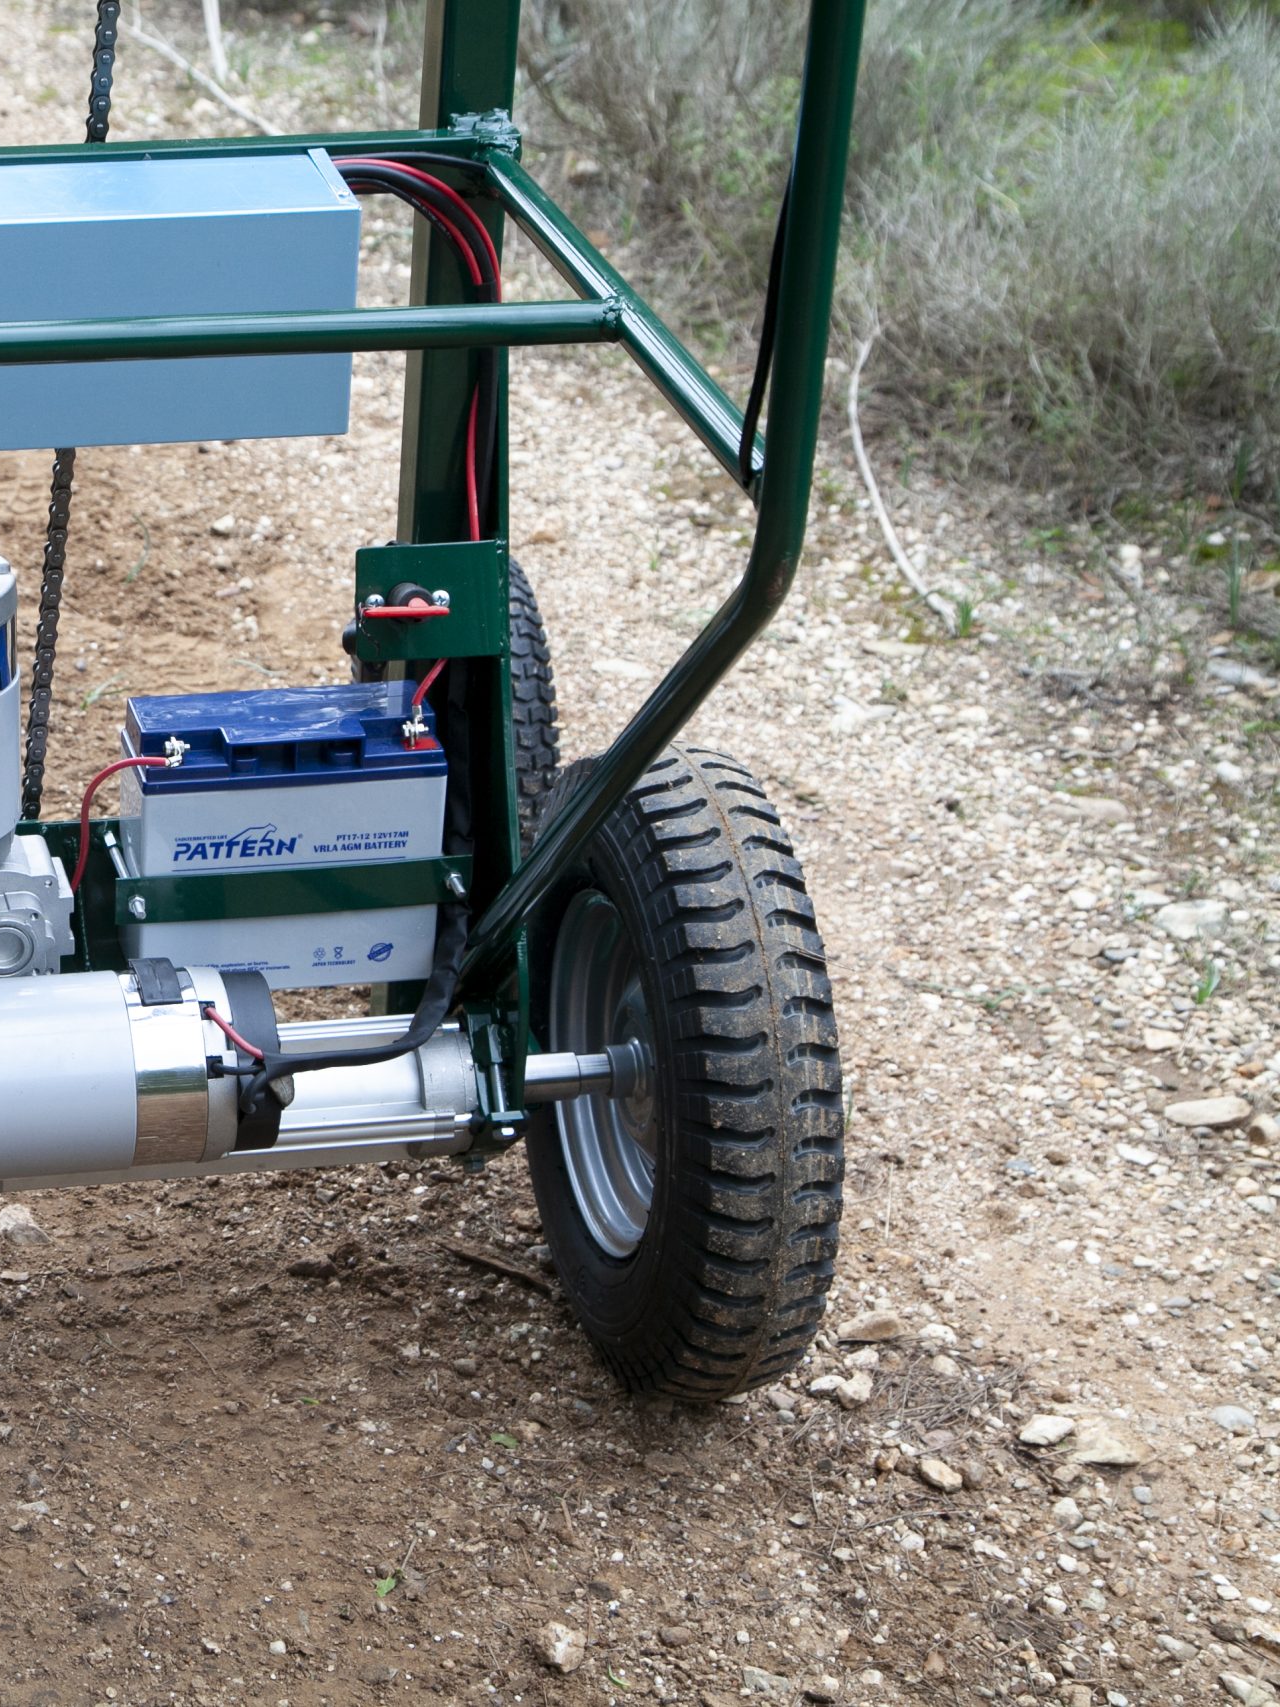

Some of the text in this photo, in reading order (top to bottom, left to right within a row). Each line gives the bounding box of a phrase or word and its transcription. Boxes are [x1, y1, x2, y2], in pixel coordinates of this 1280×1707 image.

[336, 830, 409, 841] PT17-12 12V17AH
[173, 837, 297, 861] PATTERN
[313, 840, 408, 853] VRLA AGM BATTERY
